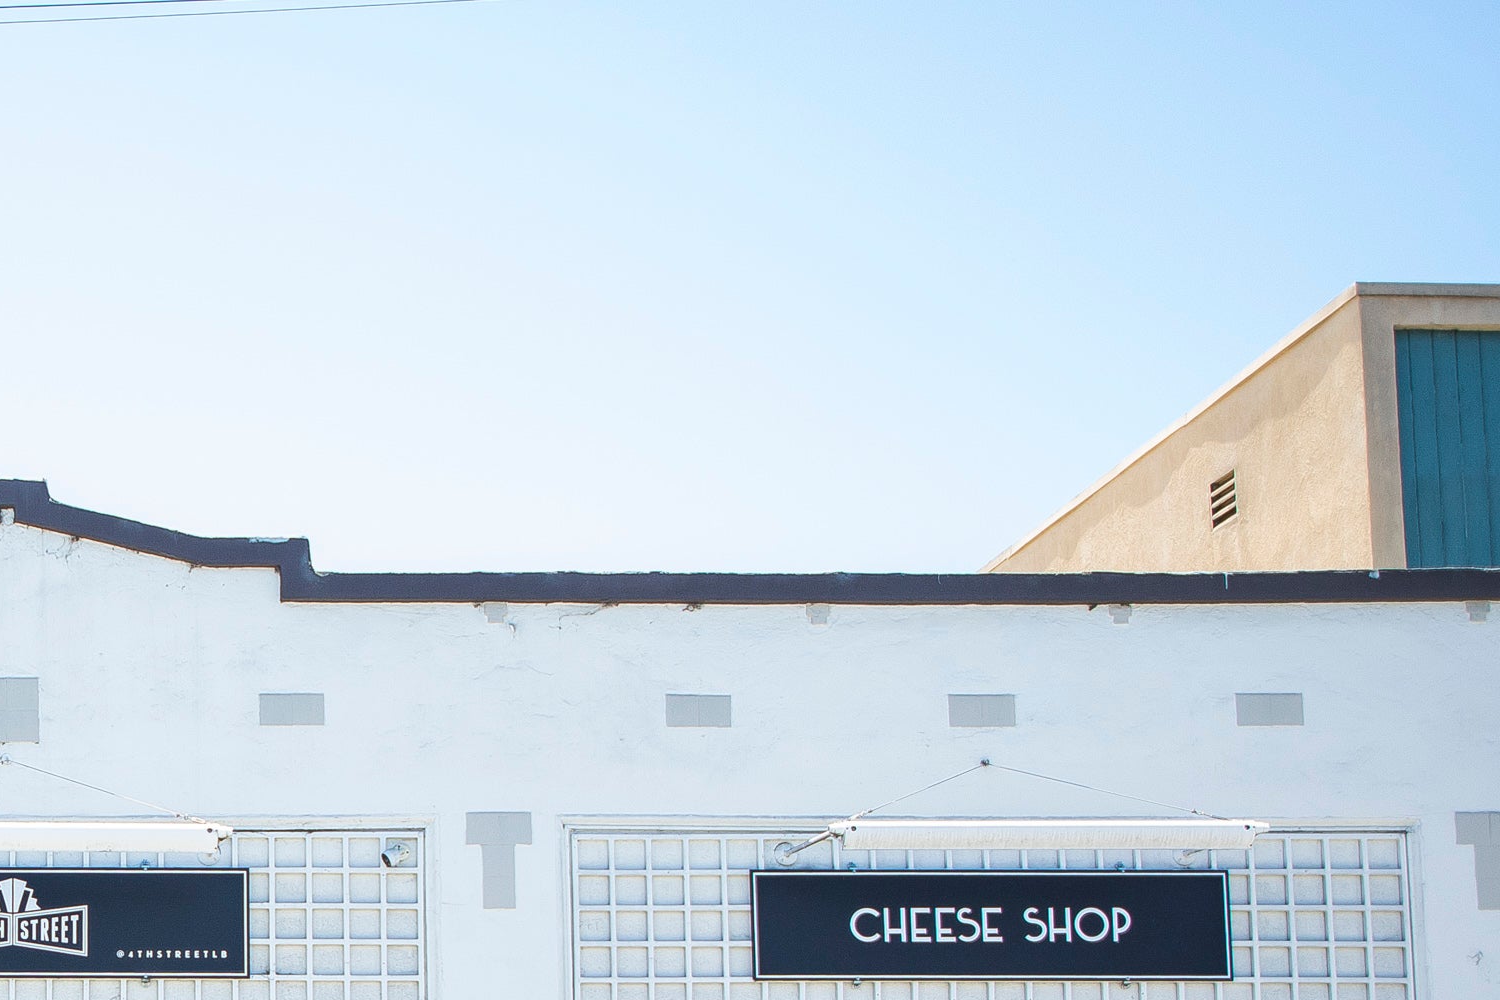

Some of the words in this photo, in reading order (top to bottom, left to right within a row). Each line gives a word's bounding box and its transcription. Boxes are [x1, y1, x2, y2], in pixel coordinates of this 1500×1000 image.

[19, 914, 80, 945] STREET
[849, 906, 1003, 943] CHEESE
[1023, 906, 1132, 943] SHOP
[116, 949, 228, 959] @4THSTREETLB
